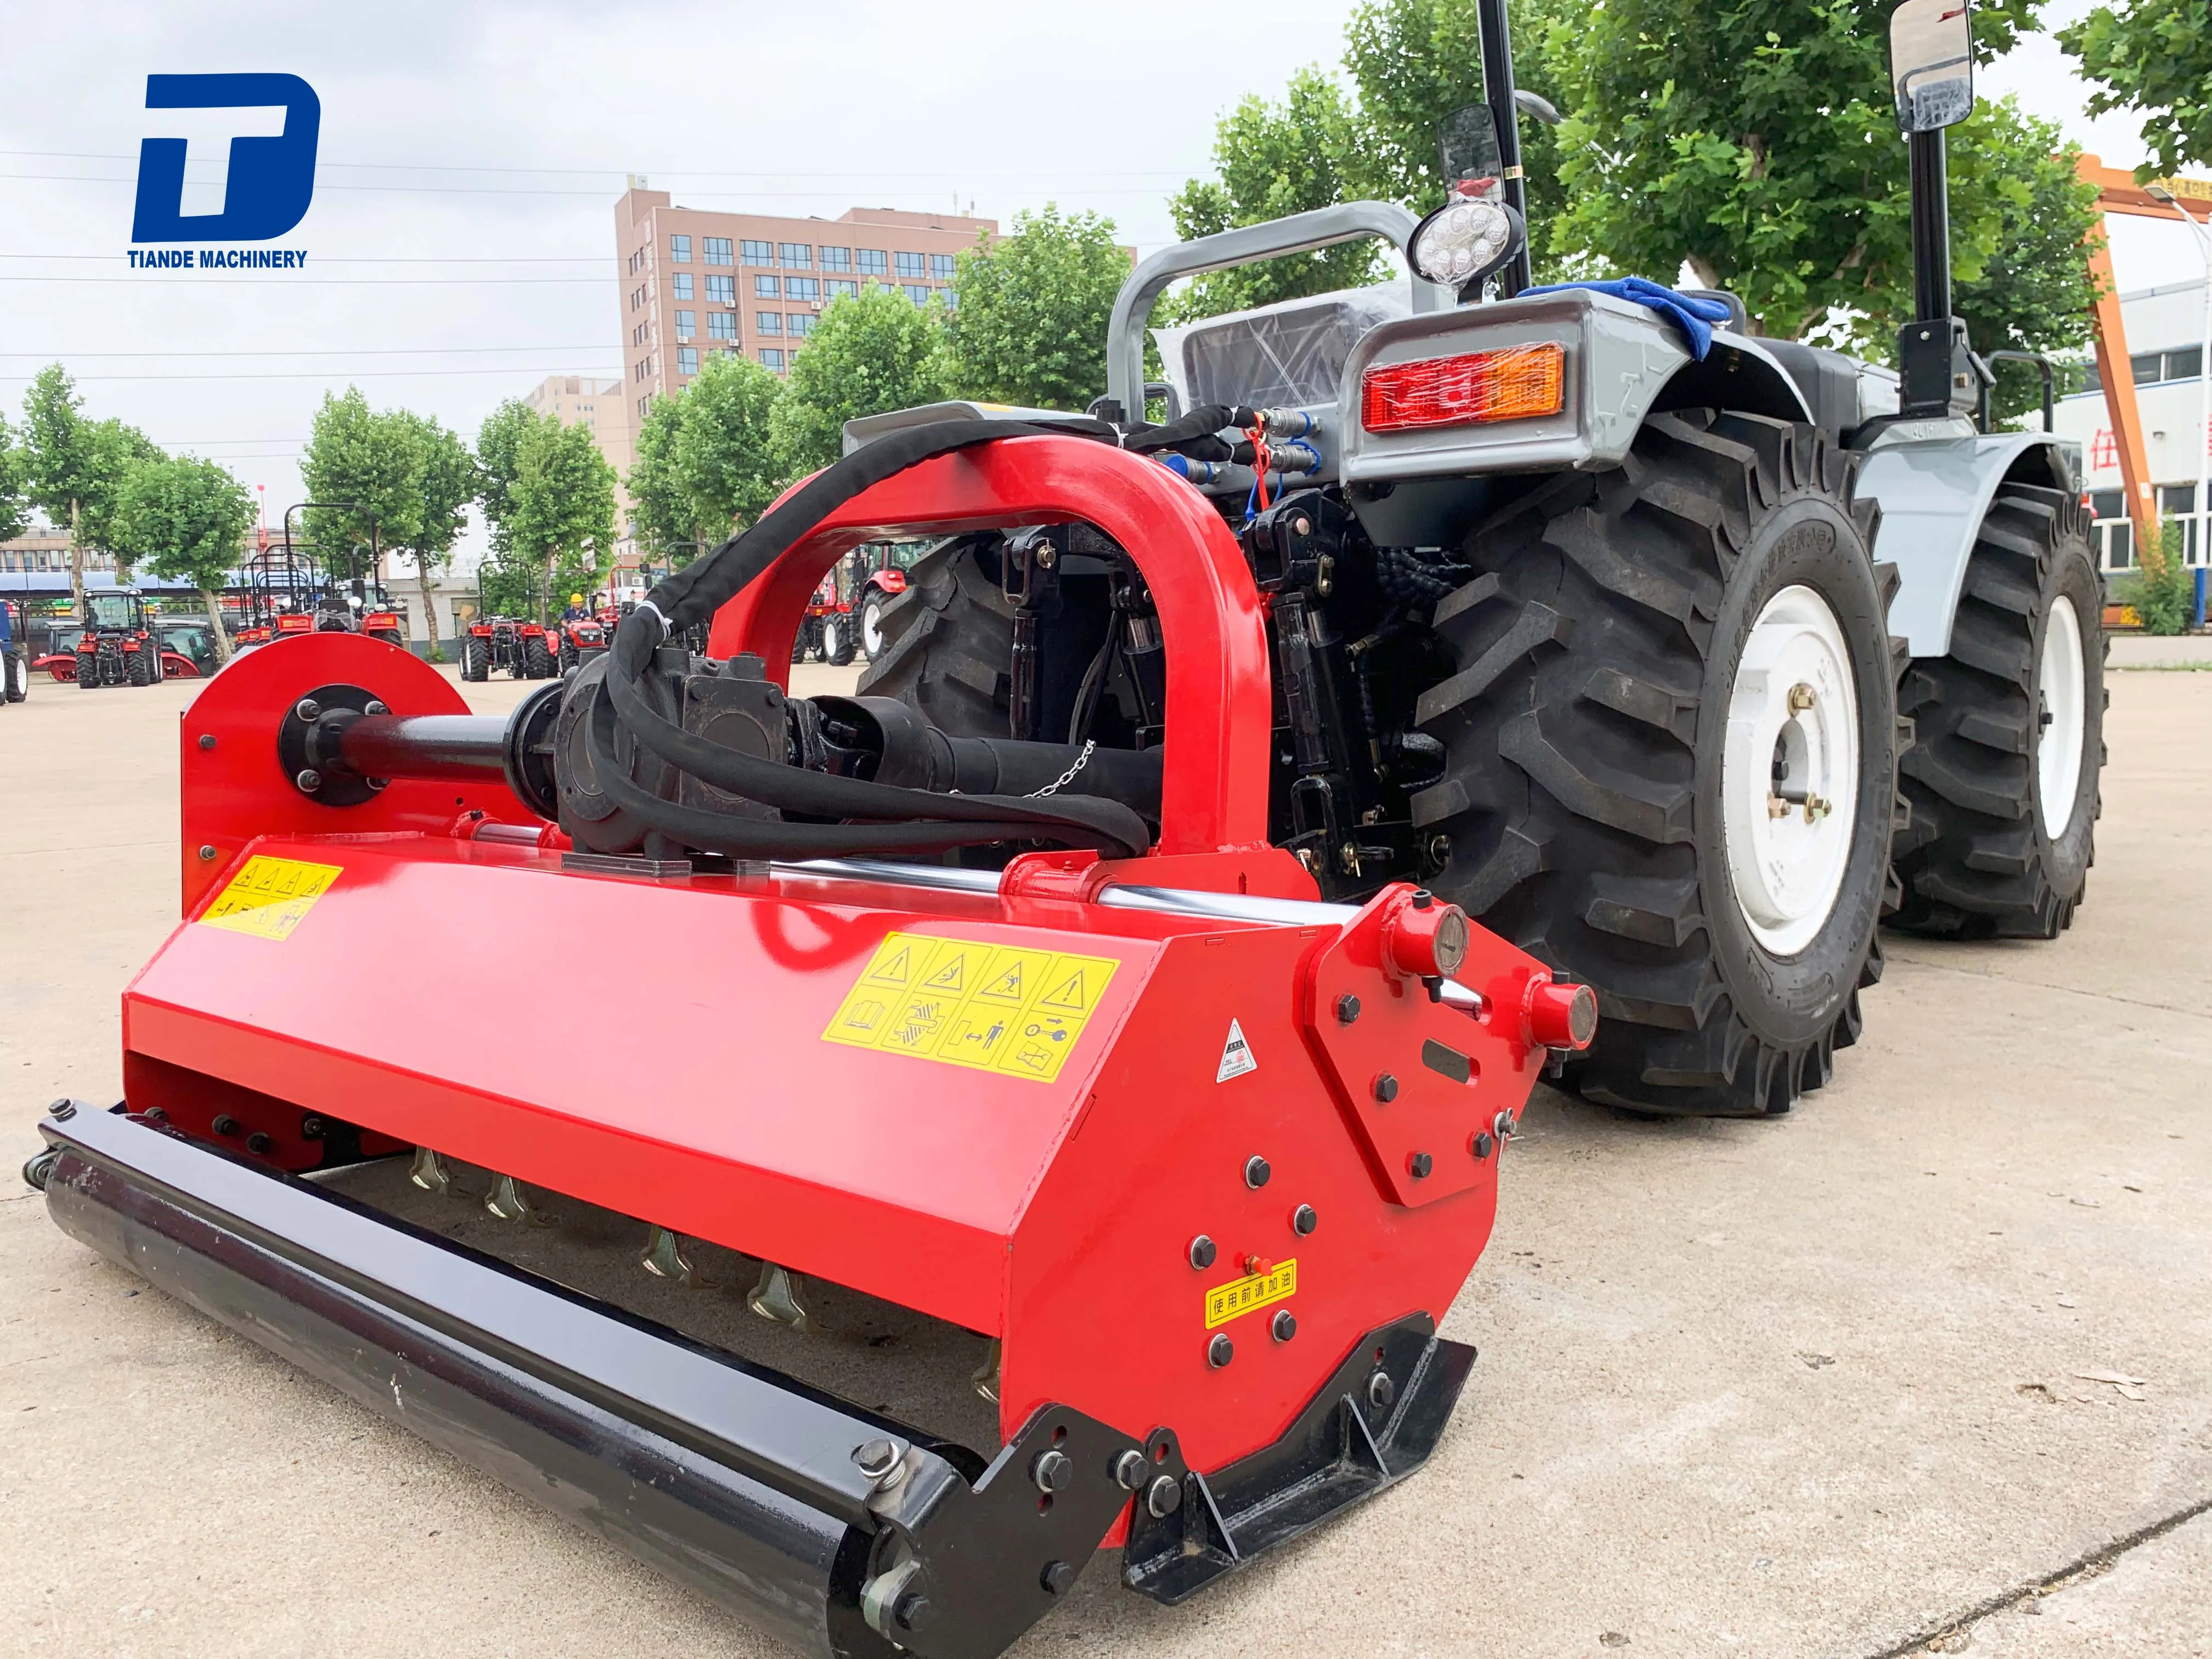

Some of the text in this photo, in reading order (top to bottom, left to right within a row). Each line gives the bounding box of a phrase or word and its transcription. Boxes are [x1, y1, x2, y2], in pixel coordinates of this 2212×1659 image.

[1214, 1272, 1290, 1314] 使用前请加油
